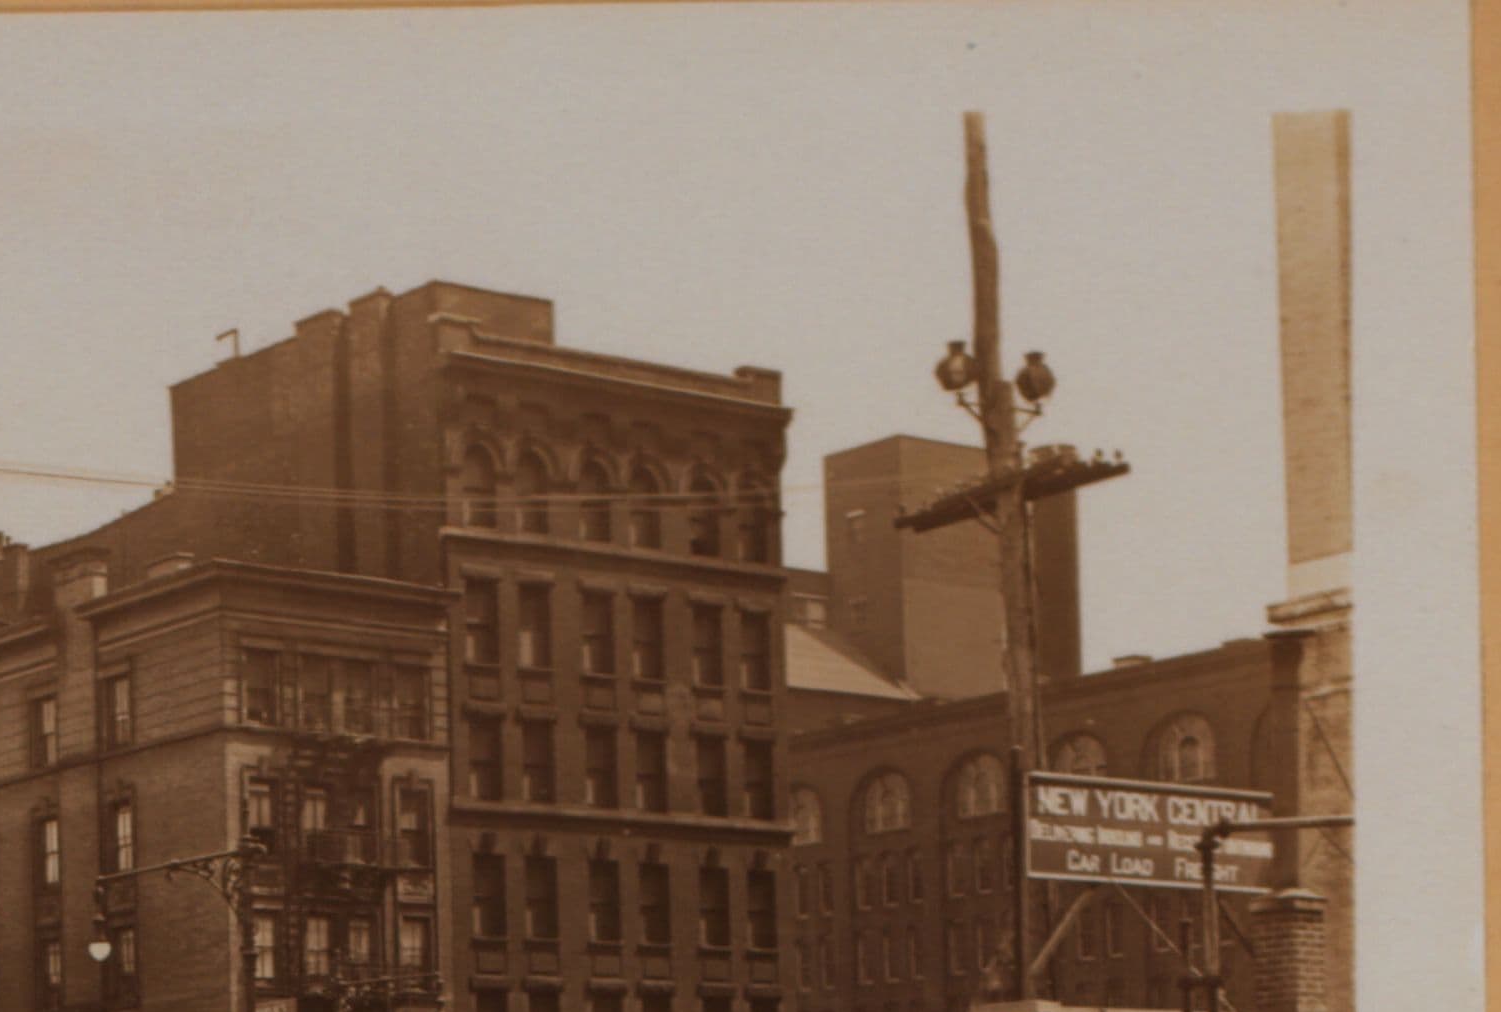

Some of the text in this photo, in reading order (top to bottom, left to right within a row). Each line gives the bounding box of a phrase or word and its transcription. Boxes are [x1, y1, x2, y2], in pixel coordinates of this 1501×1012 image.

[1036, 785, 1260, 826] NEW YORK CENTRAL
